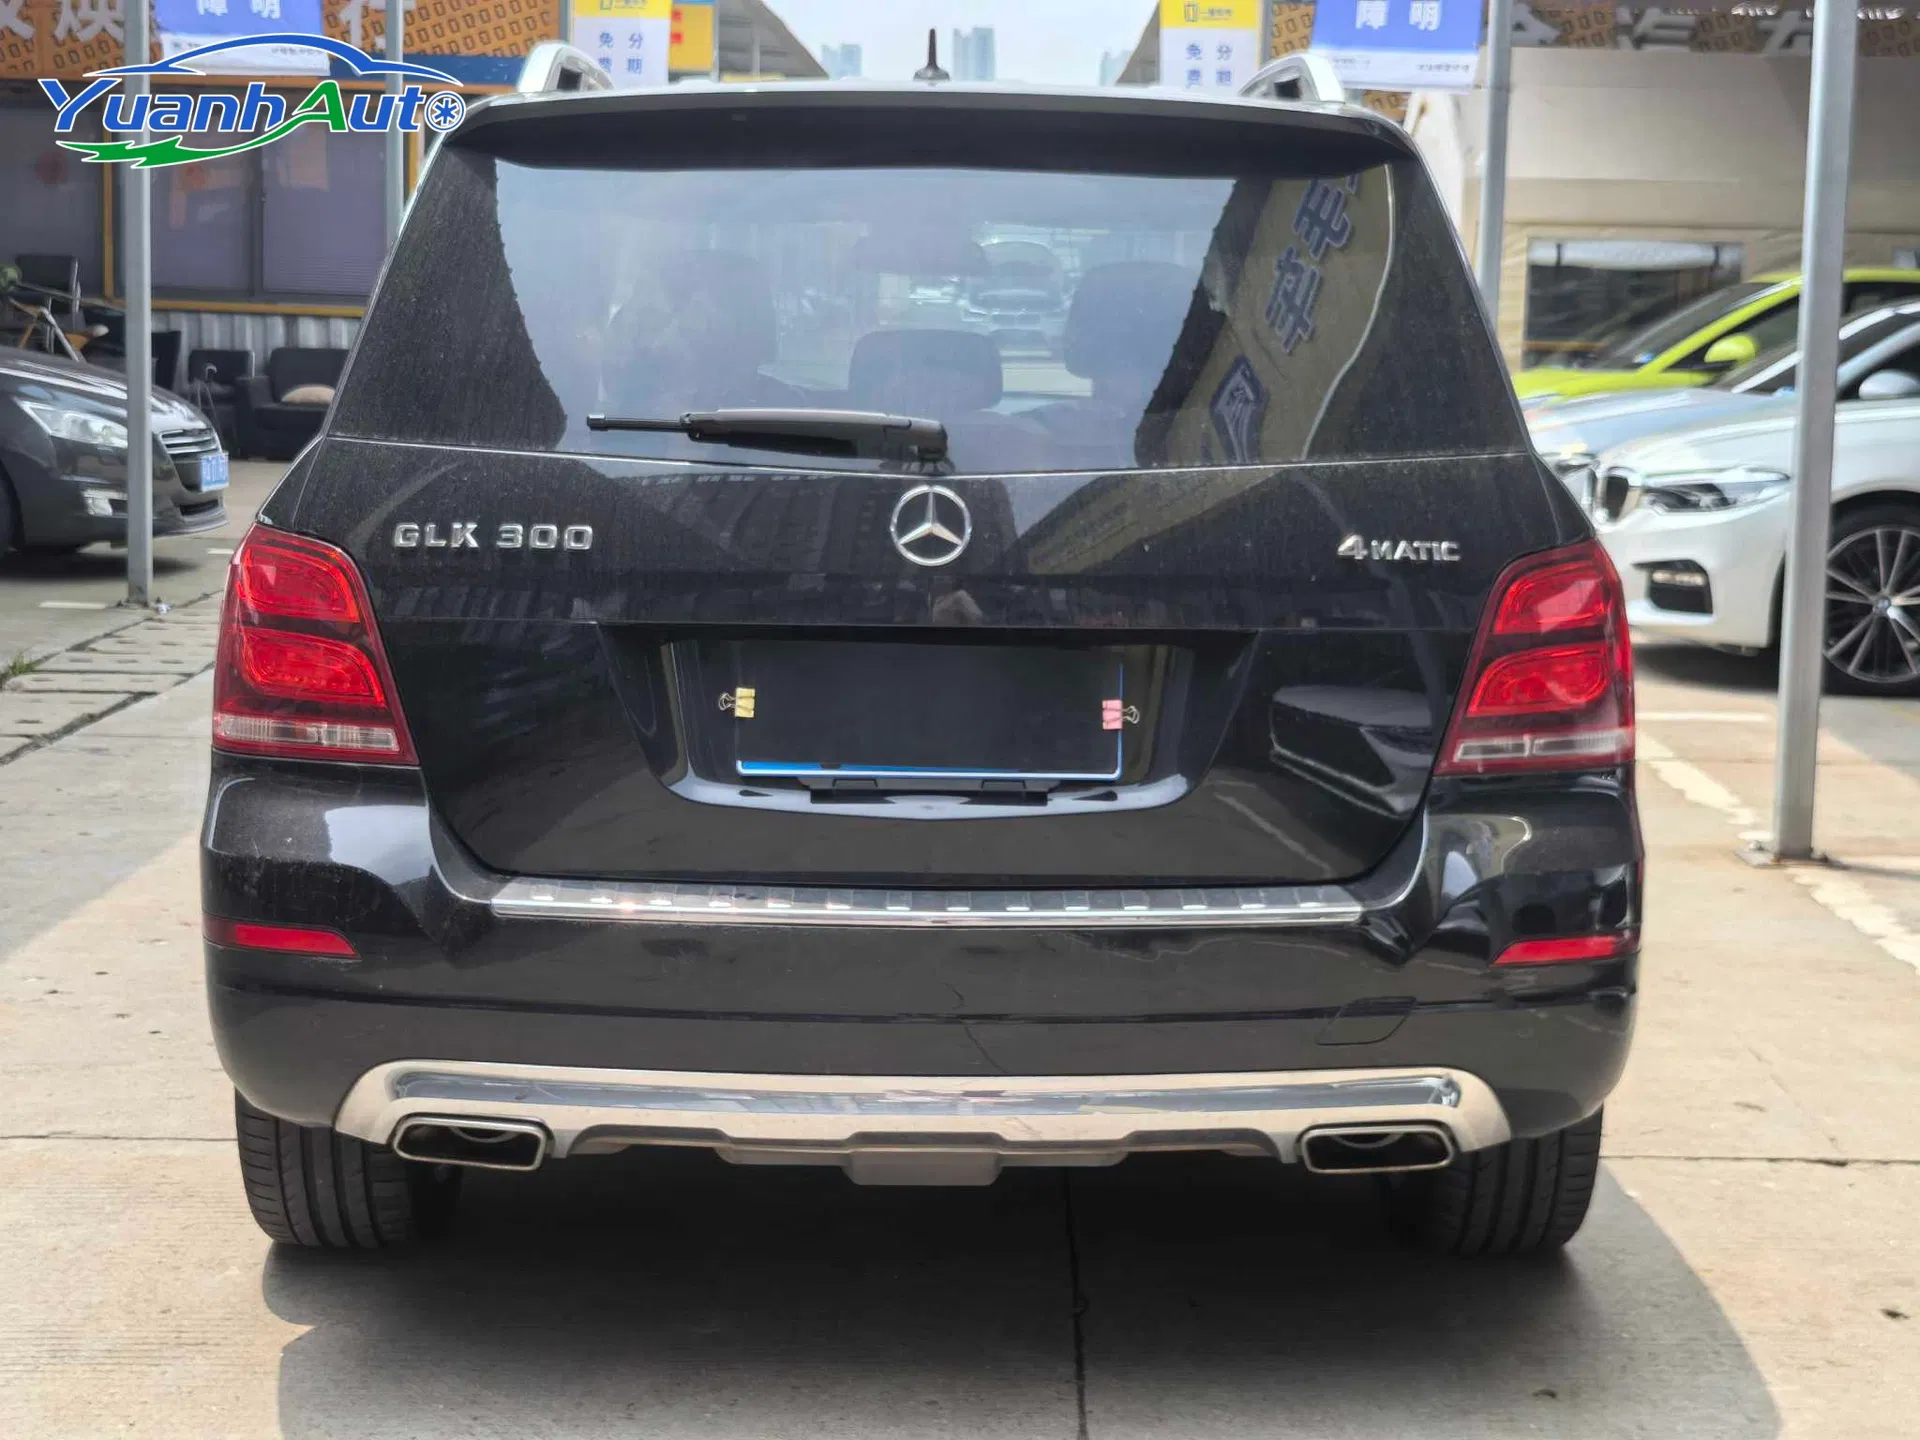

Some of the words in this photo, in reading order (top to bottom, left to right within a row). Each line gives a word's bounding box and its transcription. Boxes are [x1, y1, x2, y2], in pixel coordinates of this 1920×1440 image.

[393, 522, 480, 548] GLK
[496, 524, 593, 550] 300
[1337, 534, 1461, 562] 4MATIC
